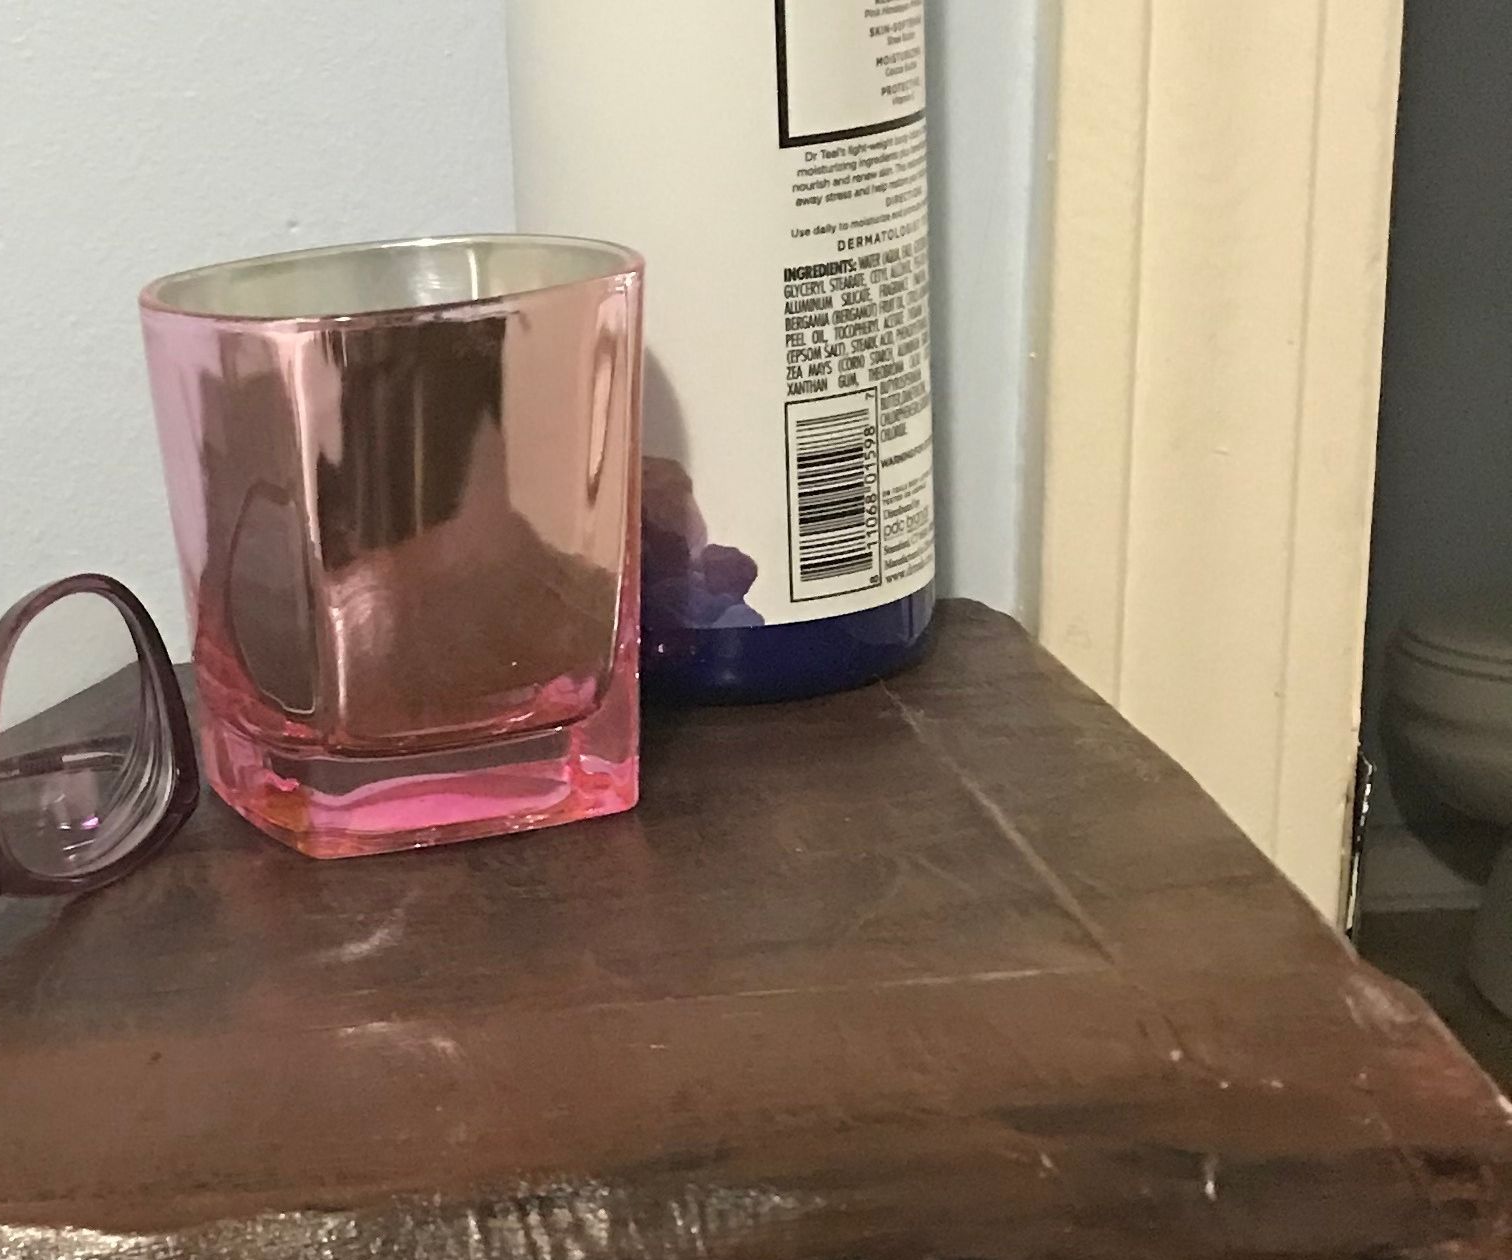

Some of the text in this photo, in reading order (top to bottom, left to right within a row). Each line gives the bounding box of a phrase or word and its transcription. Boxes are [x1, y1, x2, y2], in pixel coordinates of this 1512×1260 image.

[804, 151, 817, 162] Dr
[796, 161, 857, 177] moisturizing
[792, 178, 831, 193] nourish
[832, 174, 850, 187] and
[852, 171, 878, 184] renew
[795, 195, 823, 207] away
[825, 189, 852, 203] stress
[854, 186, 870, 198] and
[790, 228, 811, 239] Use
[813, 222, 837, 235] daily
[838, 222, 849, 231] to
[783, 258, 857, 283] INGREDIENTS:
[784, 280, 826, 299] GLYCERYL
[784, 295, 834, 315] ALUMINUM
[785, 332, 806, 348] PEEL
[786, 345, 822, 365] (EPSOM
[786, 365, 803, 381] ZEA
[808, 360, 833, 378] MAYS
[787, 376, 828, 397] XANTHAN
[865, 391, 876, 400] 7
[863, 425, 878, 485] 01598
[865, 493, 879, 550] 11068
[884, 519, 906, 541] pdc
